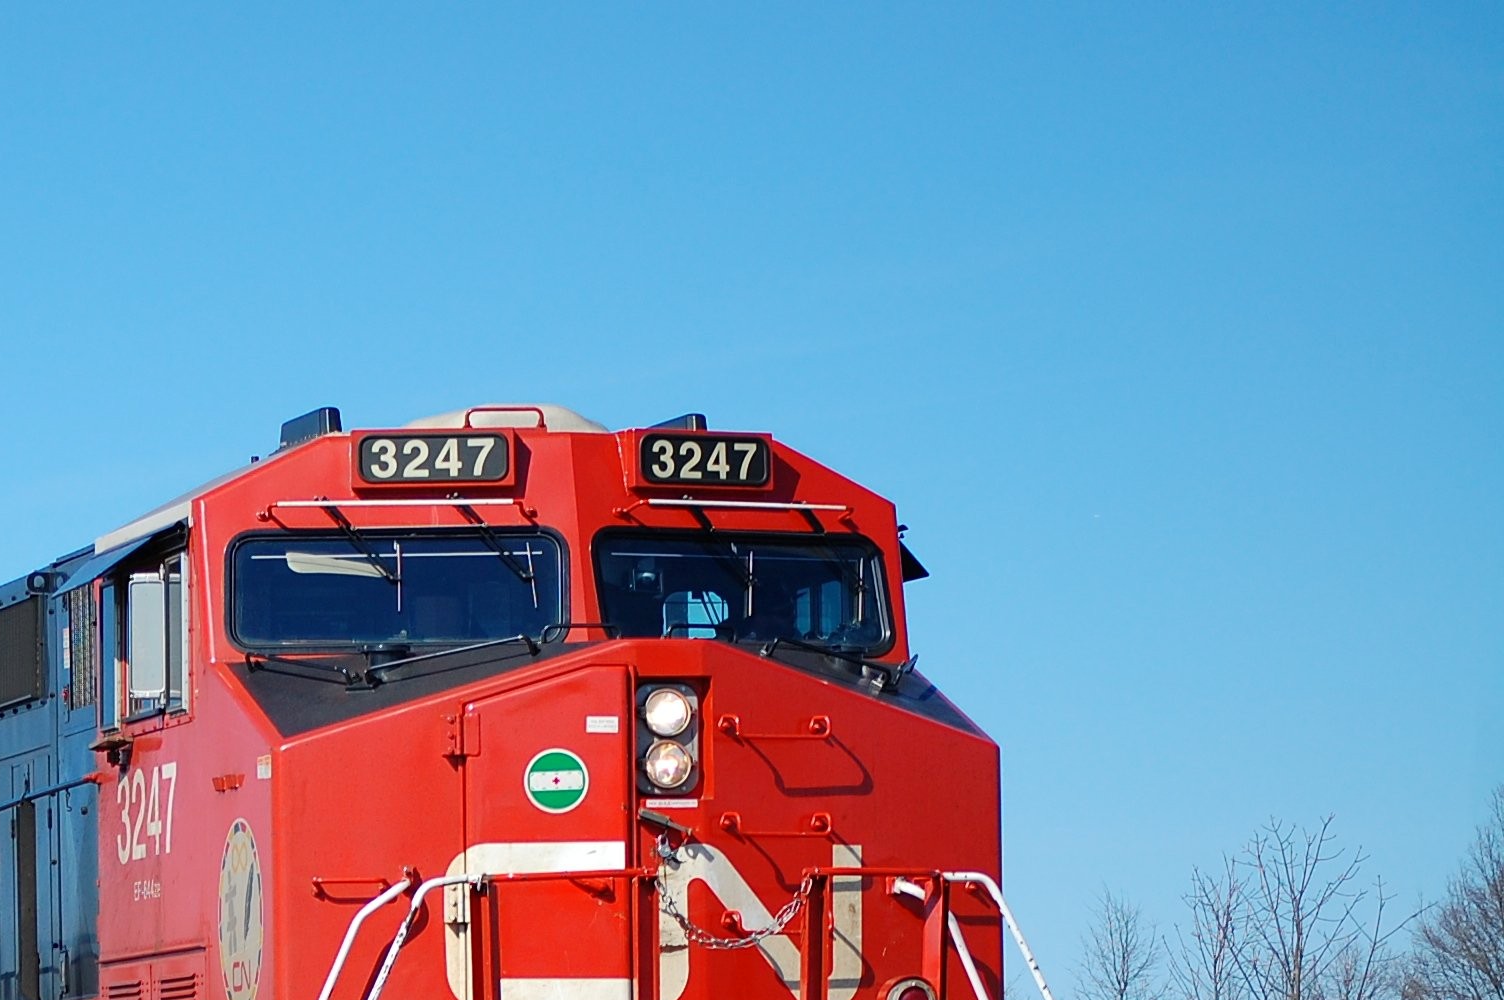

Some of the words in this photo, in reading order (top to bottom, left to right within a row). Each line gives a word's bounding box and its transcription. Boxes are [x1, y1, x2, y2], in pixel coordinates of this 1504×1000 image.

[370, 438, 495, 479] 3247
[651, 439, 758, 481] 3247
[117, 761, 177, 865] 3247
[232, 959, 251, 993] CN
